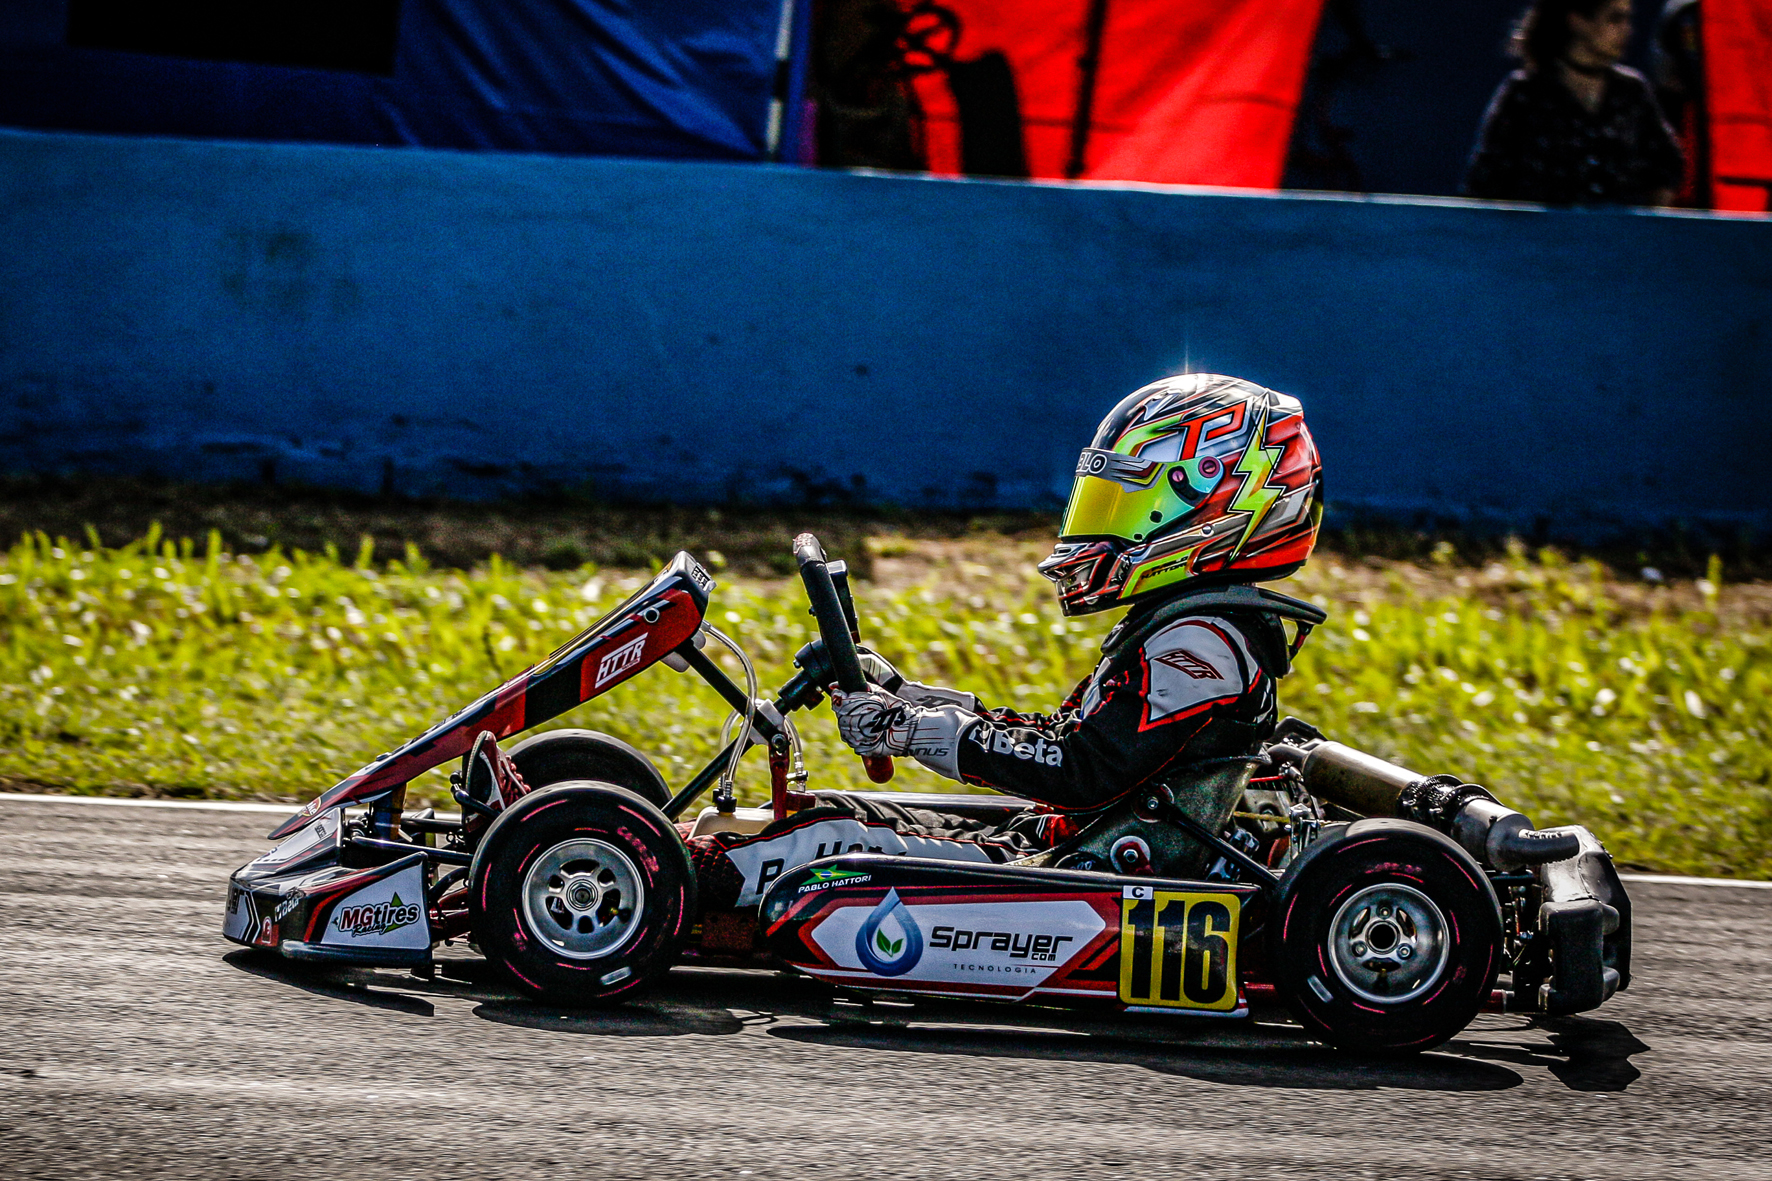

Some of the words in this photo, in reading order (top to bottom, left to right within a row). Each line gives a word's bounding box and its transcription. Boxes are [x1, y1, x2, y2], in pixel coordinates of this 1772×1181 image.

[595, 634, 647, 687] HTTR
[993, 730, 1063, 768] Beta
[798, 882, 830, 893] PABLO
[831, 875, 872, 887] HATTORI
[1131, 886, 1145, 898] C
[340, 903, 420, 930] MGtires
[929, 925, 1073, 958] Sprayer
[1127, 899, 1232, 1004] 116
[953, 963, 1036, 973] TECNOLOGIA
[1031, 952, 1056, 961] com
